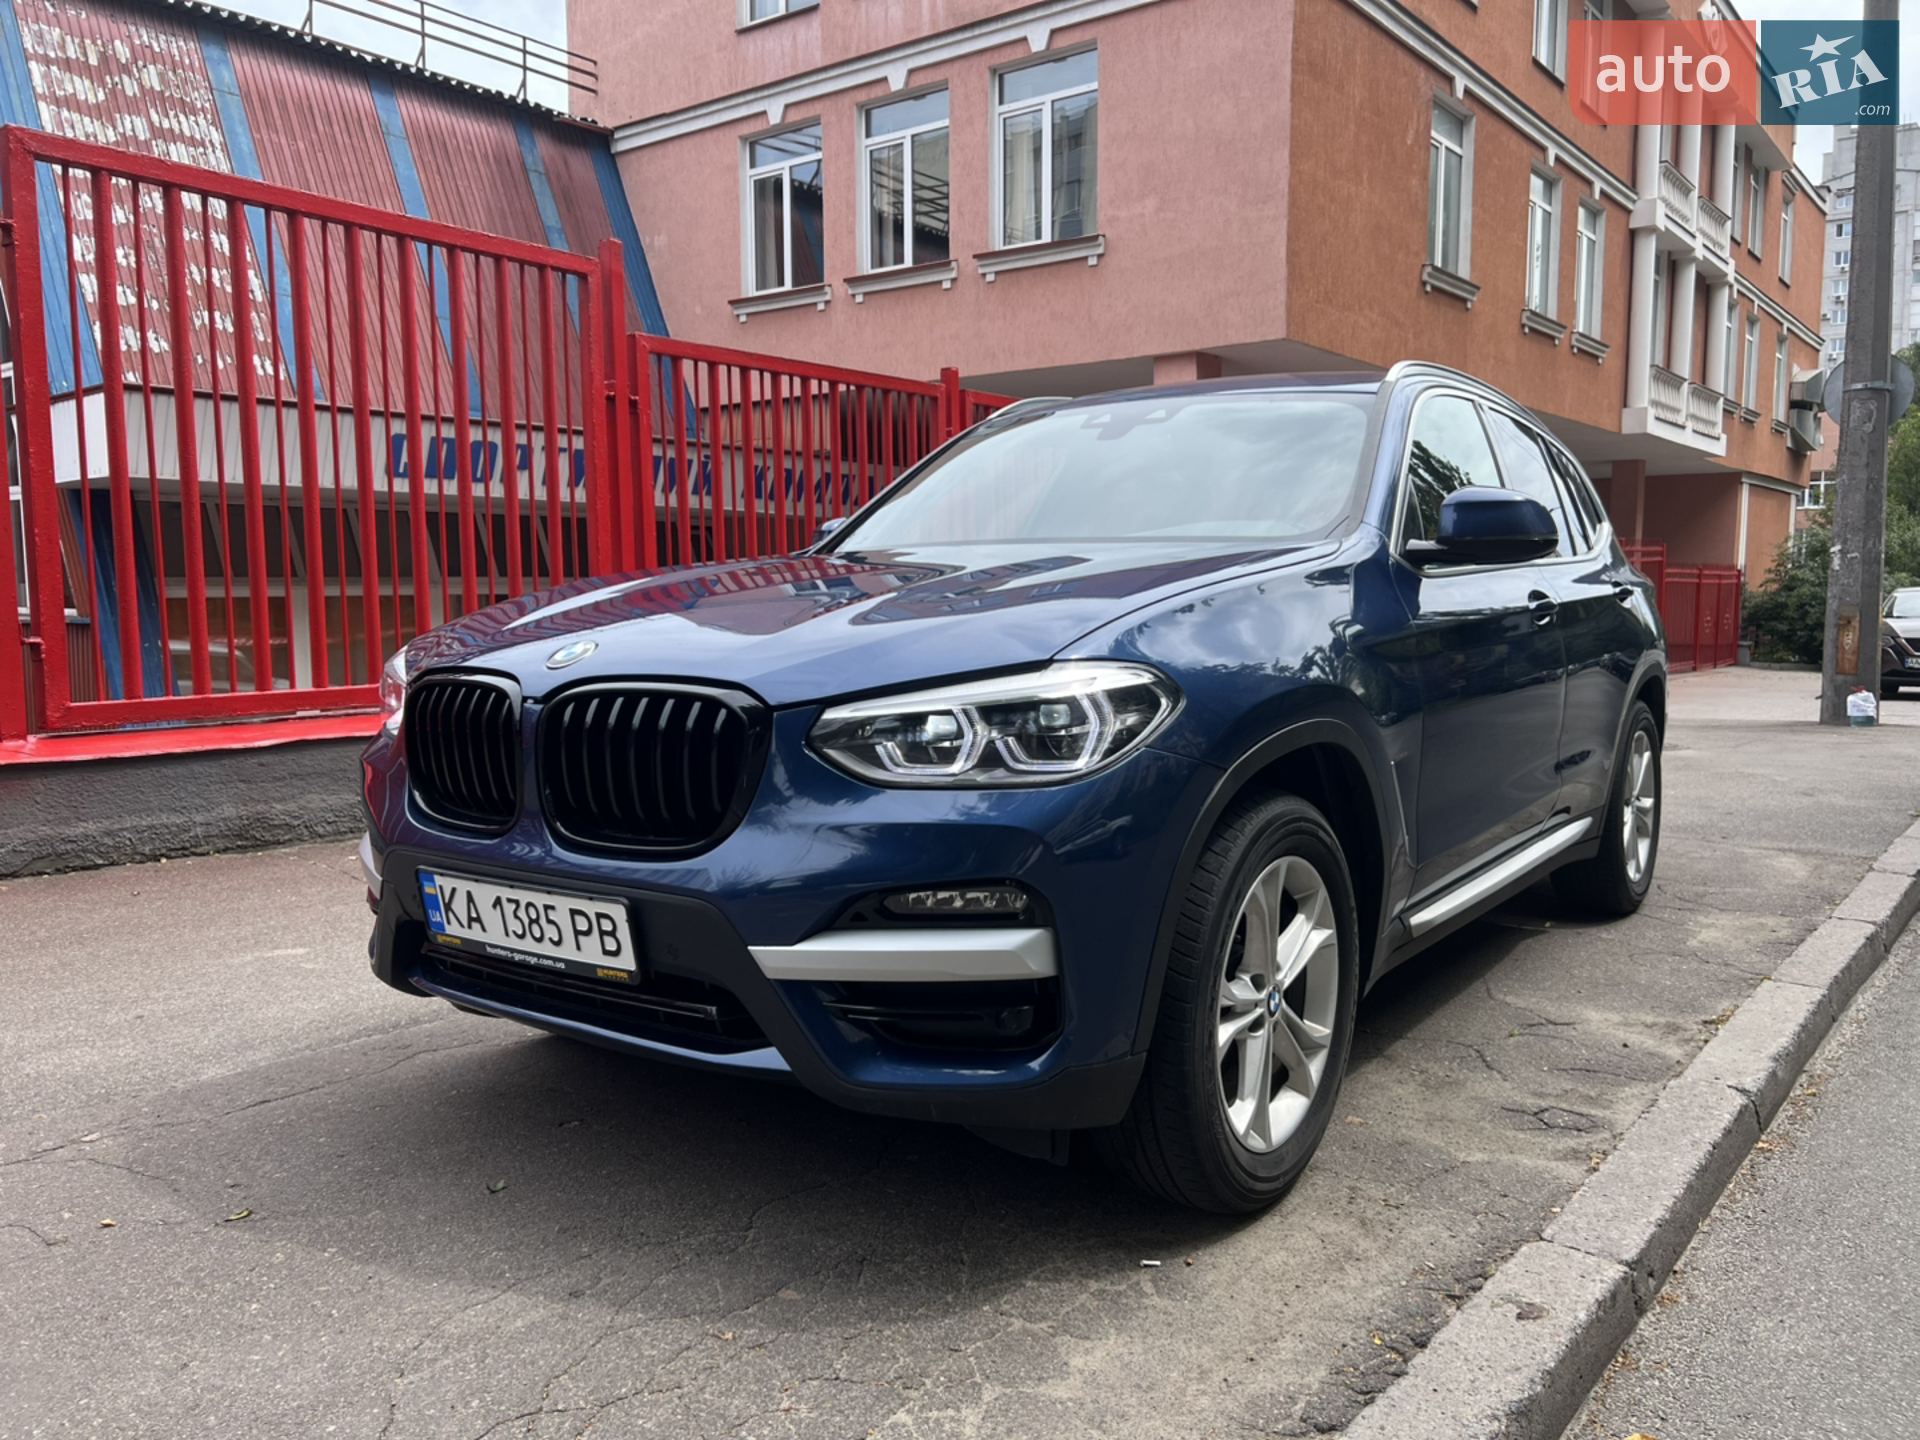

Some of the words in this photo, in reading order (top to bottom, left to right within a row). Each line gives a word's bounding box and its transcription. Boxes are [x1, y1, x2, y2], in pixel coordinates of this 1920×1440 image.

[429, 909, 443, 923] UA
[438, 884, 487, 933] KA
[491, 895, 564, 947] 1385
[568, 907, 623, 957] PB
[486, 944, 565, 968] hunters-garage.com.ua
